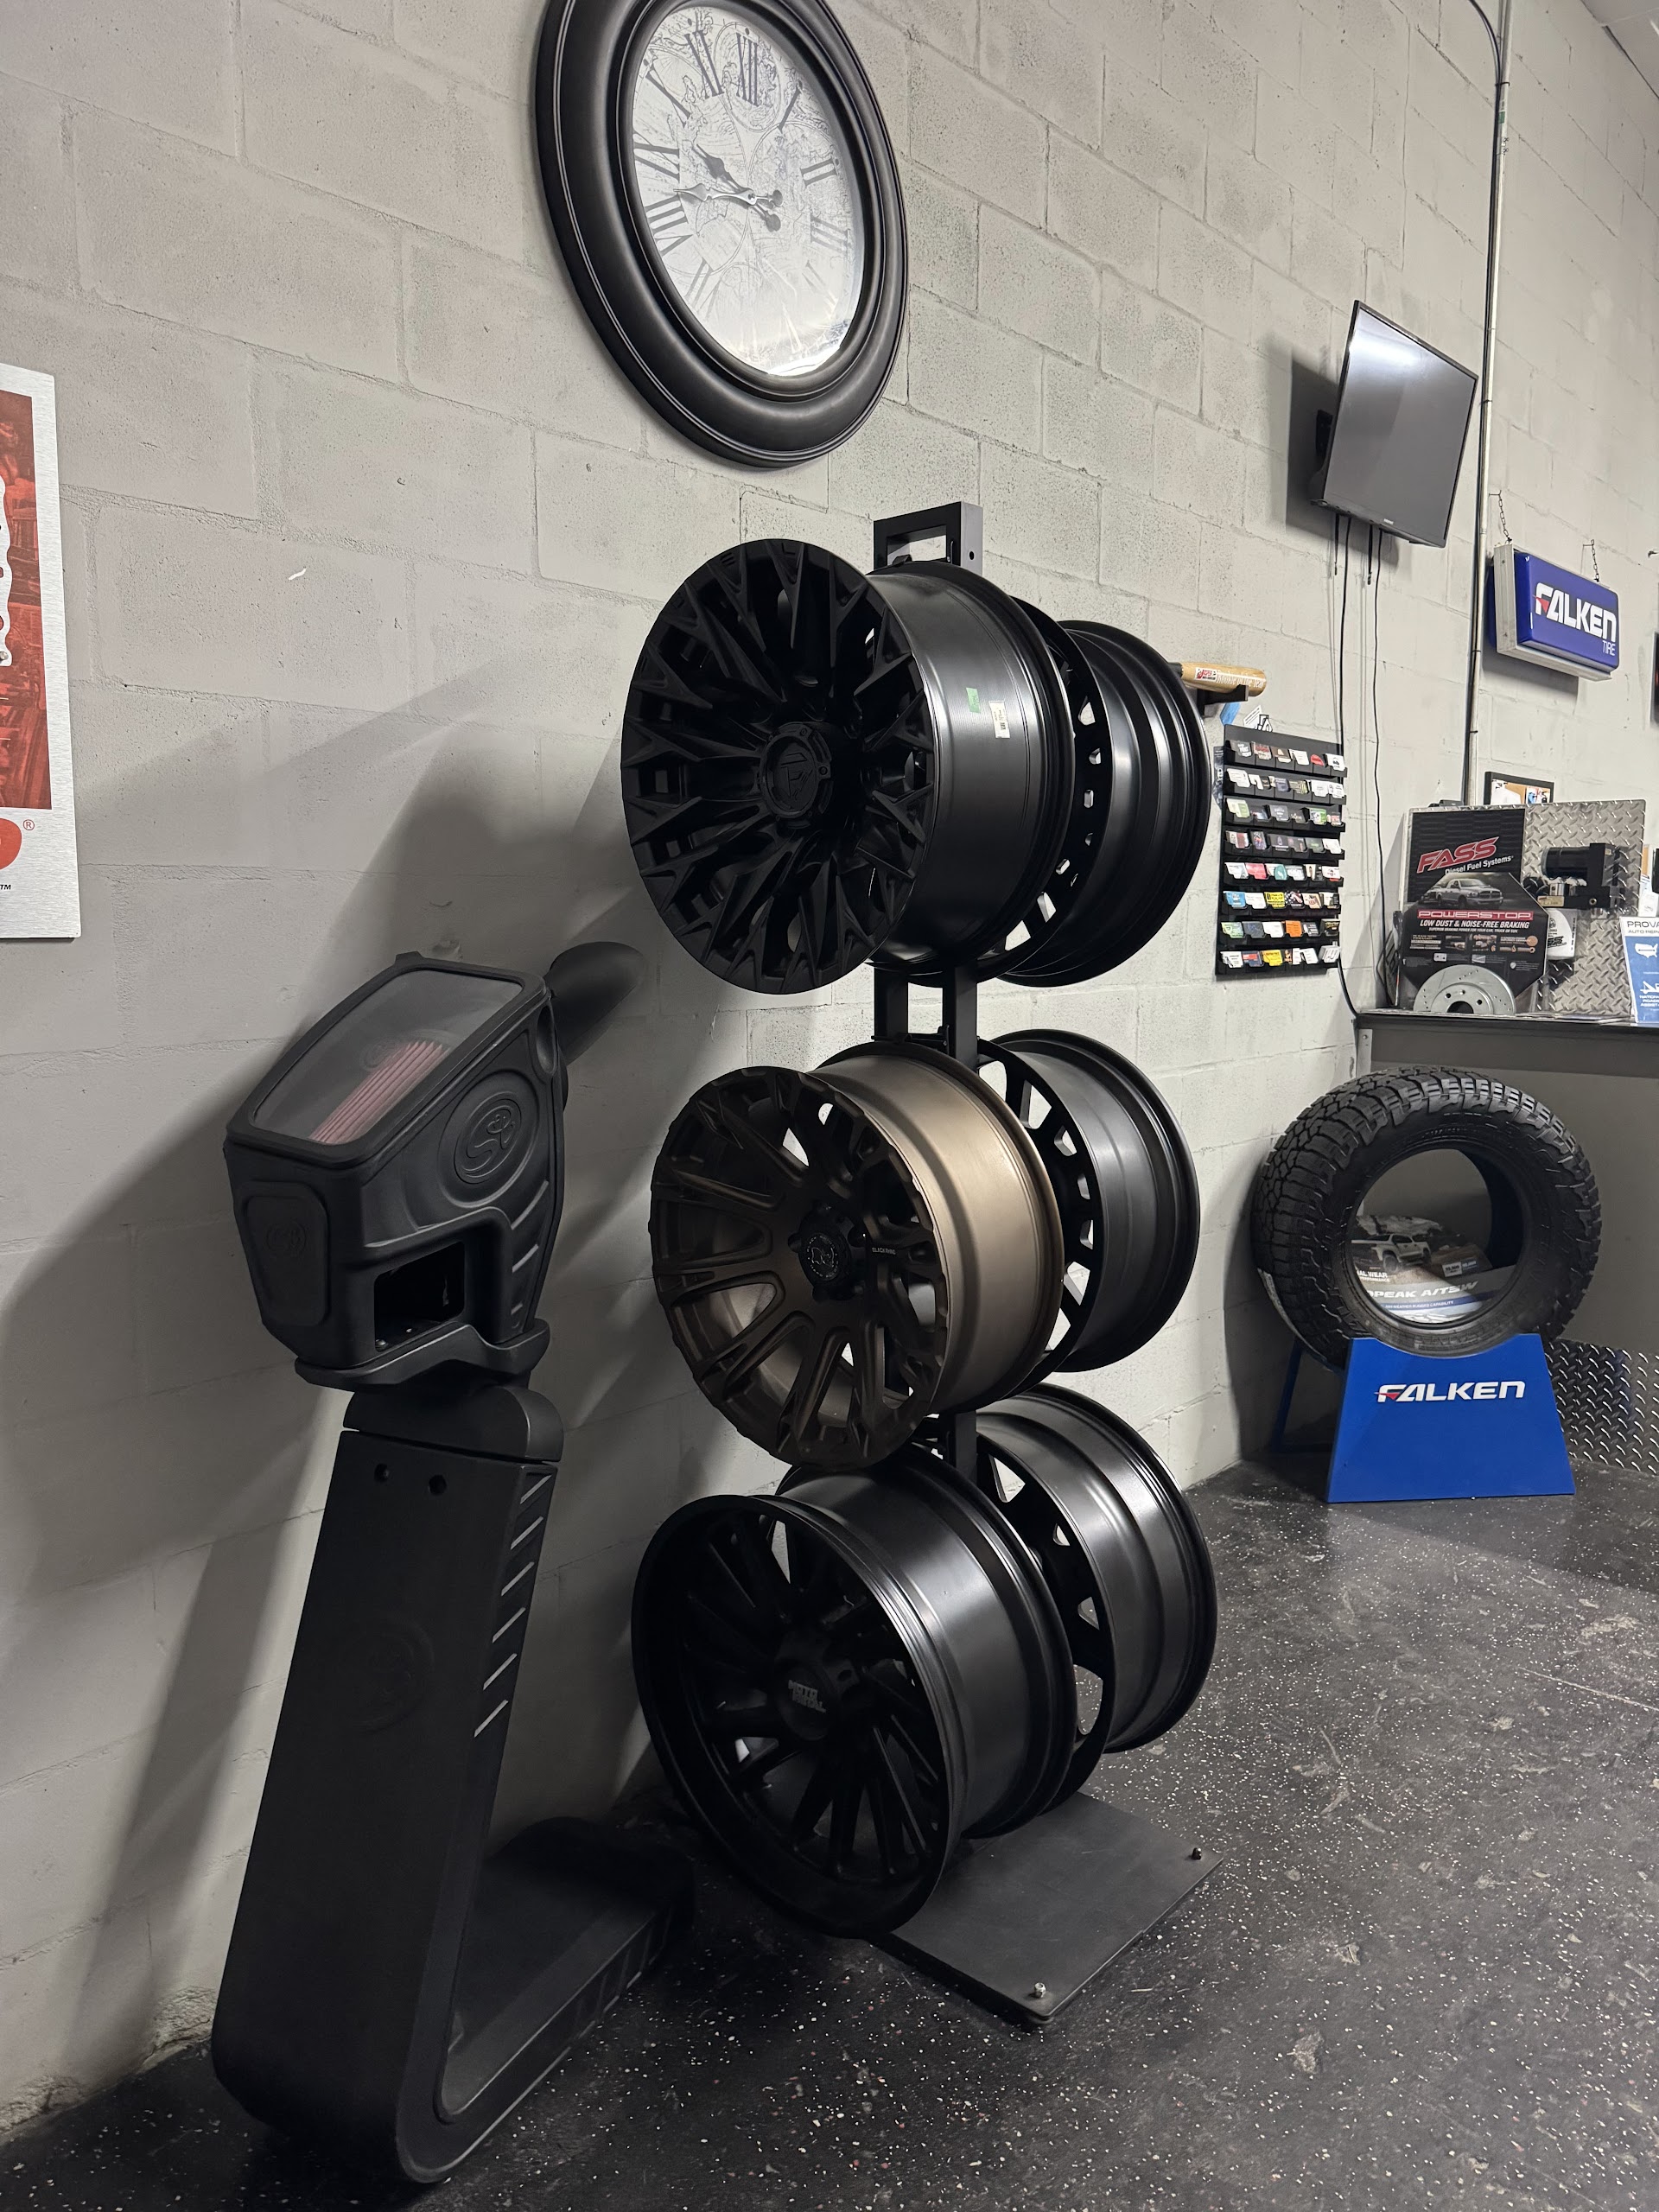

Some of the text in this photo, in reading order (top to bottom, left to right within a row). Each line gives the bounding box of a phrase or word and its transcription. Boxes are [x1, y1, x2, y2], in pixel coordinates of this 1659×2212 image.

[735, 32, 760, 107] XII
[1535, 582, 1617, 643] FALKEN
[1602, 640, 1616, 656] TIRE
[1417, 836, 1500, 874] FASS
[1466, 861, 1483, 871] Fuel
[1483, 855, 1512, 868] Systems
[1418, 911, 1531, 919] POWERSTOP
[1376, 1380, 1526, 1403] FALKEN
